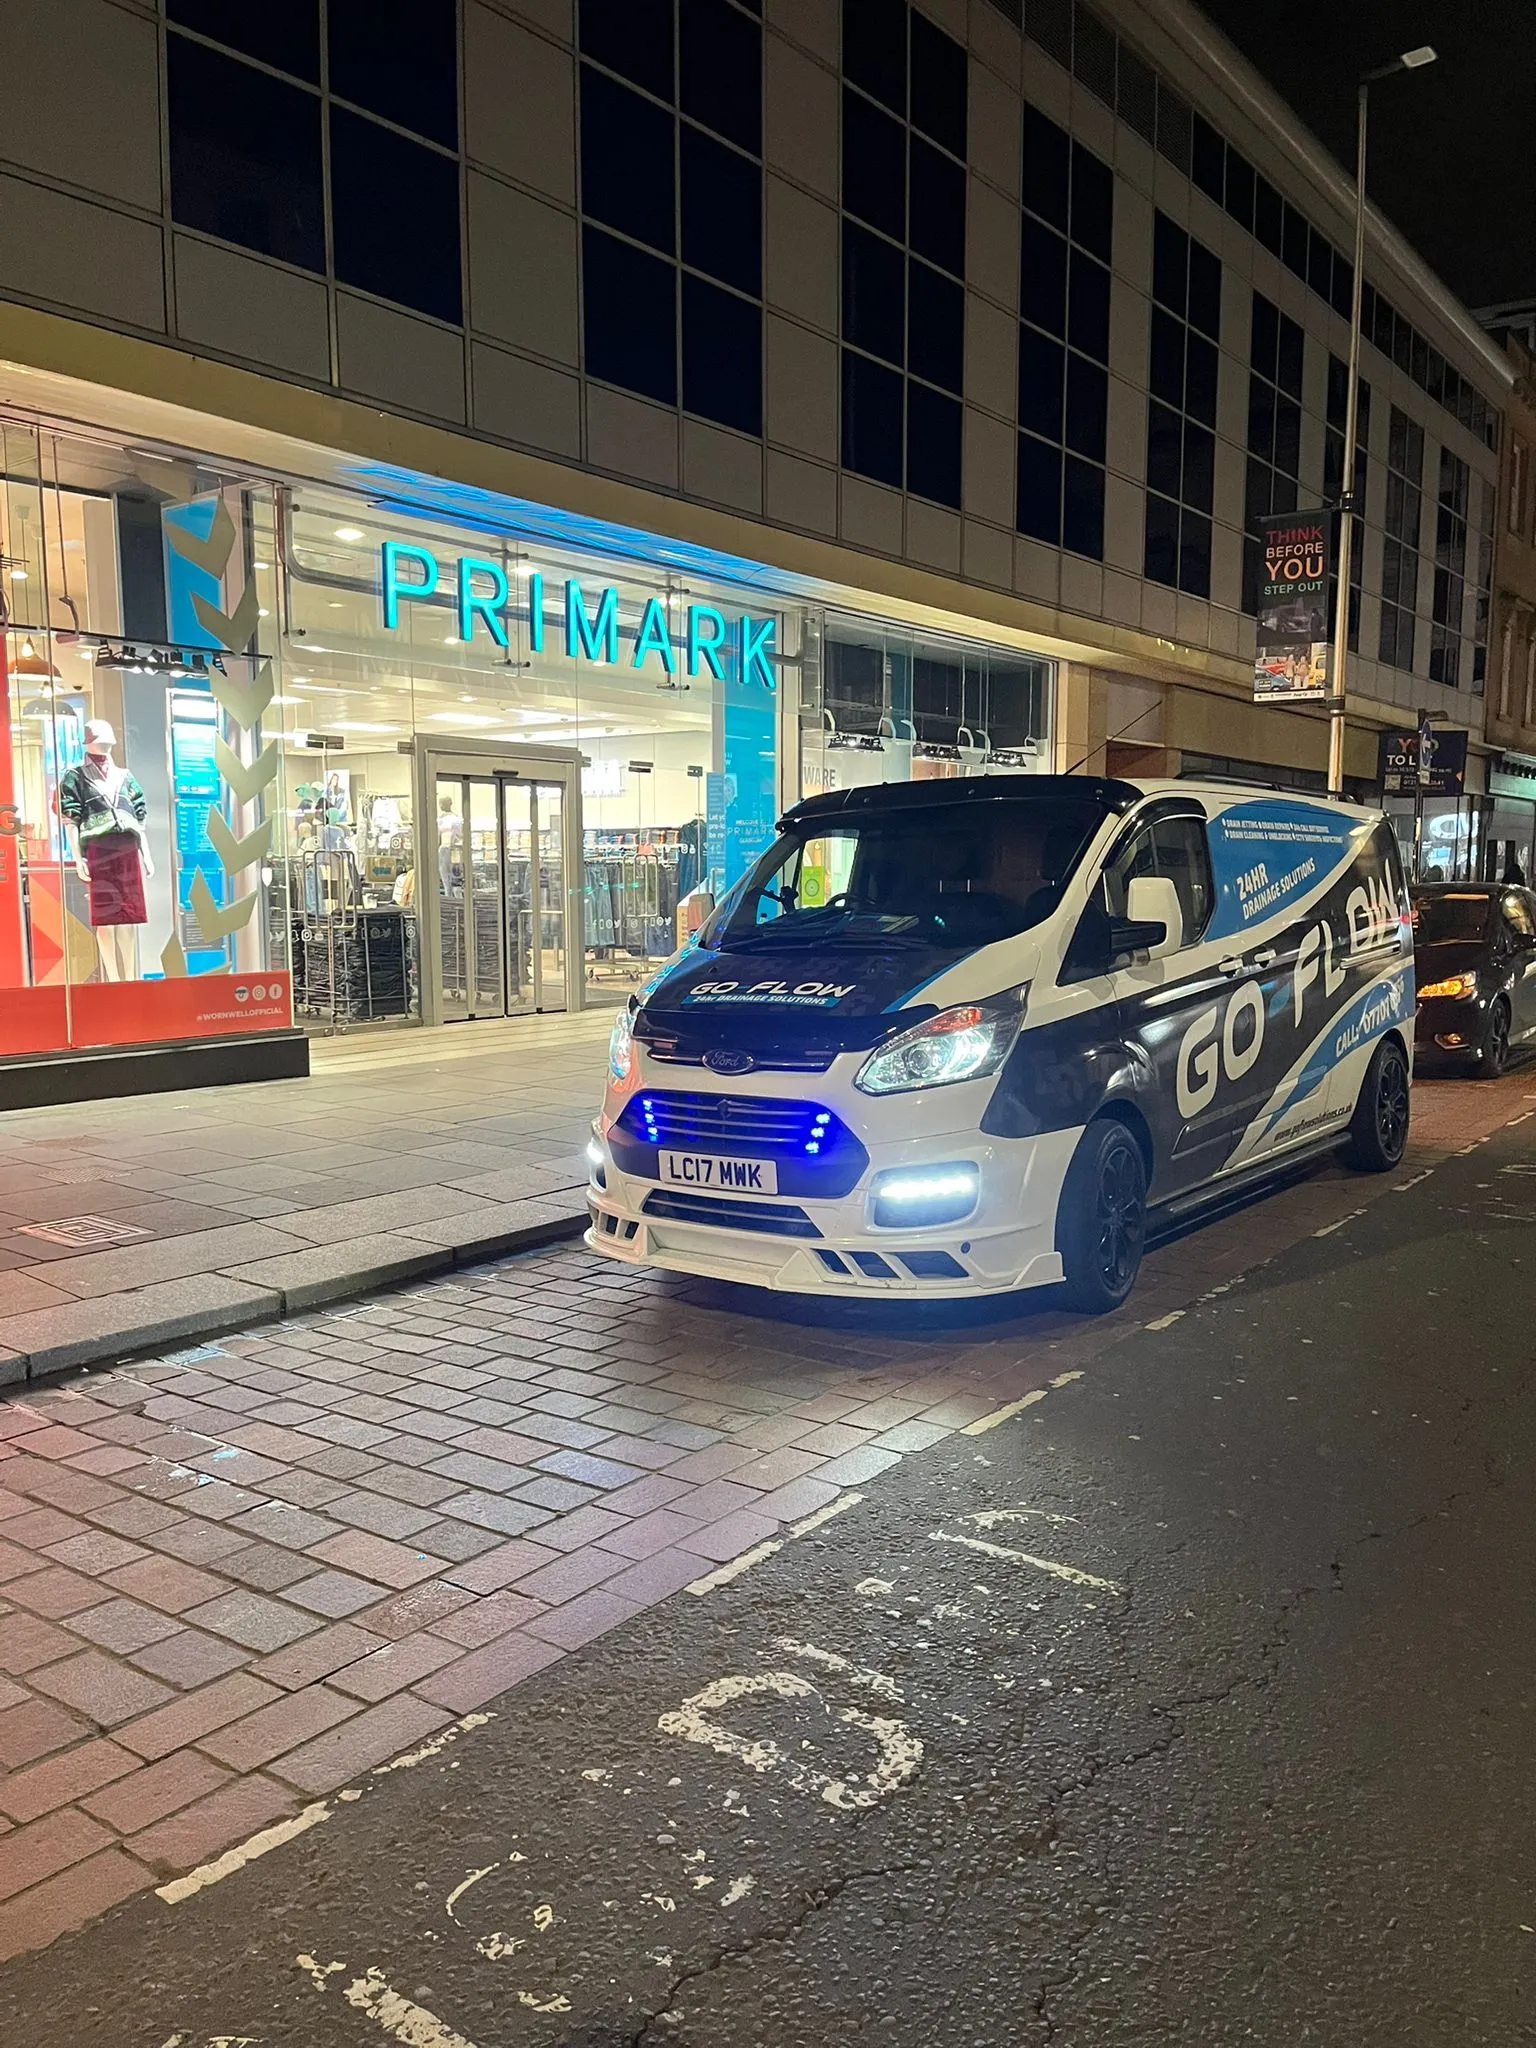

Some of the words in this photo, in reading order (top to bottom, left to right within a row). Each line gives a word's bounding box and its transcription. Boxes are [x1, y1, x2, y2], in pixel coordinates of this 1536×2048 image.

[1265, 525, 1324, 545] THINK
[1266, 542, 1324, 558] BEFORE
[1265, 556, 1323, 581] YOU
[1264, 584, 1294, 595] STEP
[1298, 581, 1323, 592] OUT
[382, 541, 776, 688] PRIMARK
[1387, 755, 1406, 766] TO
[727, 827, 775, 836] PRIMARK
[1236, 862, 1268, 901] 24HR
[1242, 882, 1281, 920] DRAINAGE
[1280, 857, 1316, 894] SOLUTIONS
[690, 981, 739, 995] GO
[746, 981, 857, 998] FLOW
[1176, 979, 1265, 1119] GO
[1293, 858, 1401, 1028] FLOW
[716, 994, 768, 1003] DRAINAGE
[767, 994, 829, 1006] SOLUTIONS
[710, 1051, 740, 1067] Ford
[669, 1155, 713, 1183] LC17
[719, 1160, 762, 1188] MWK
